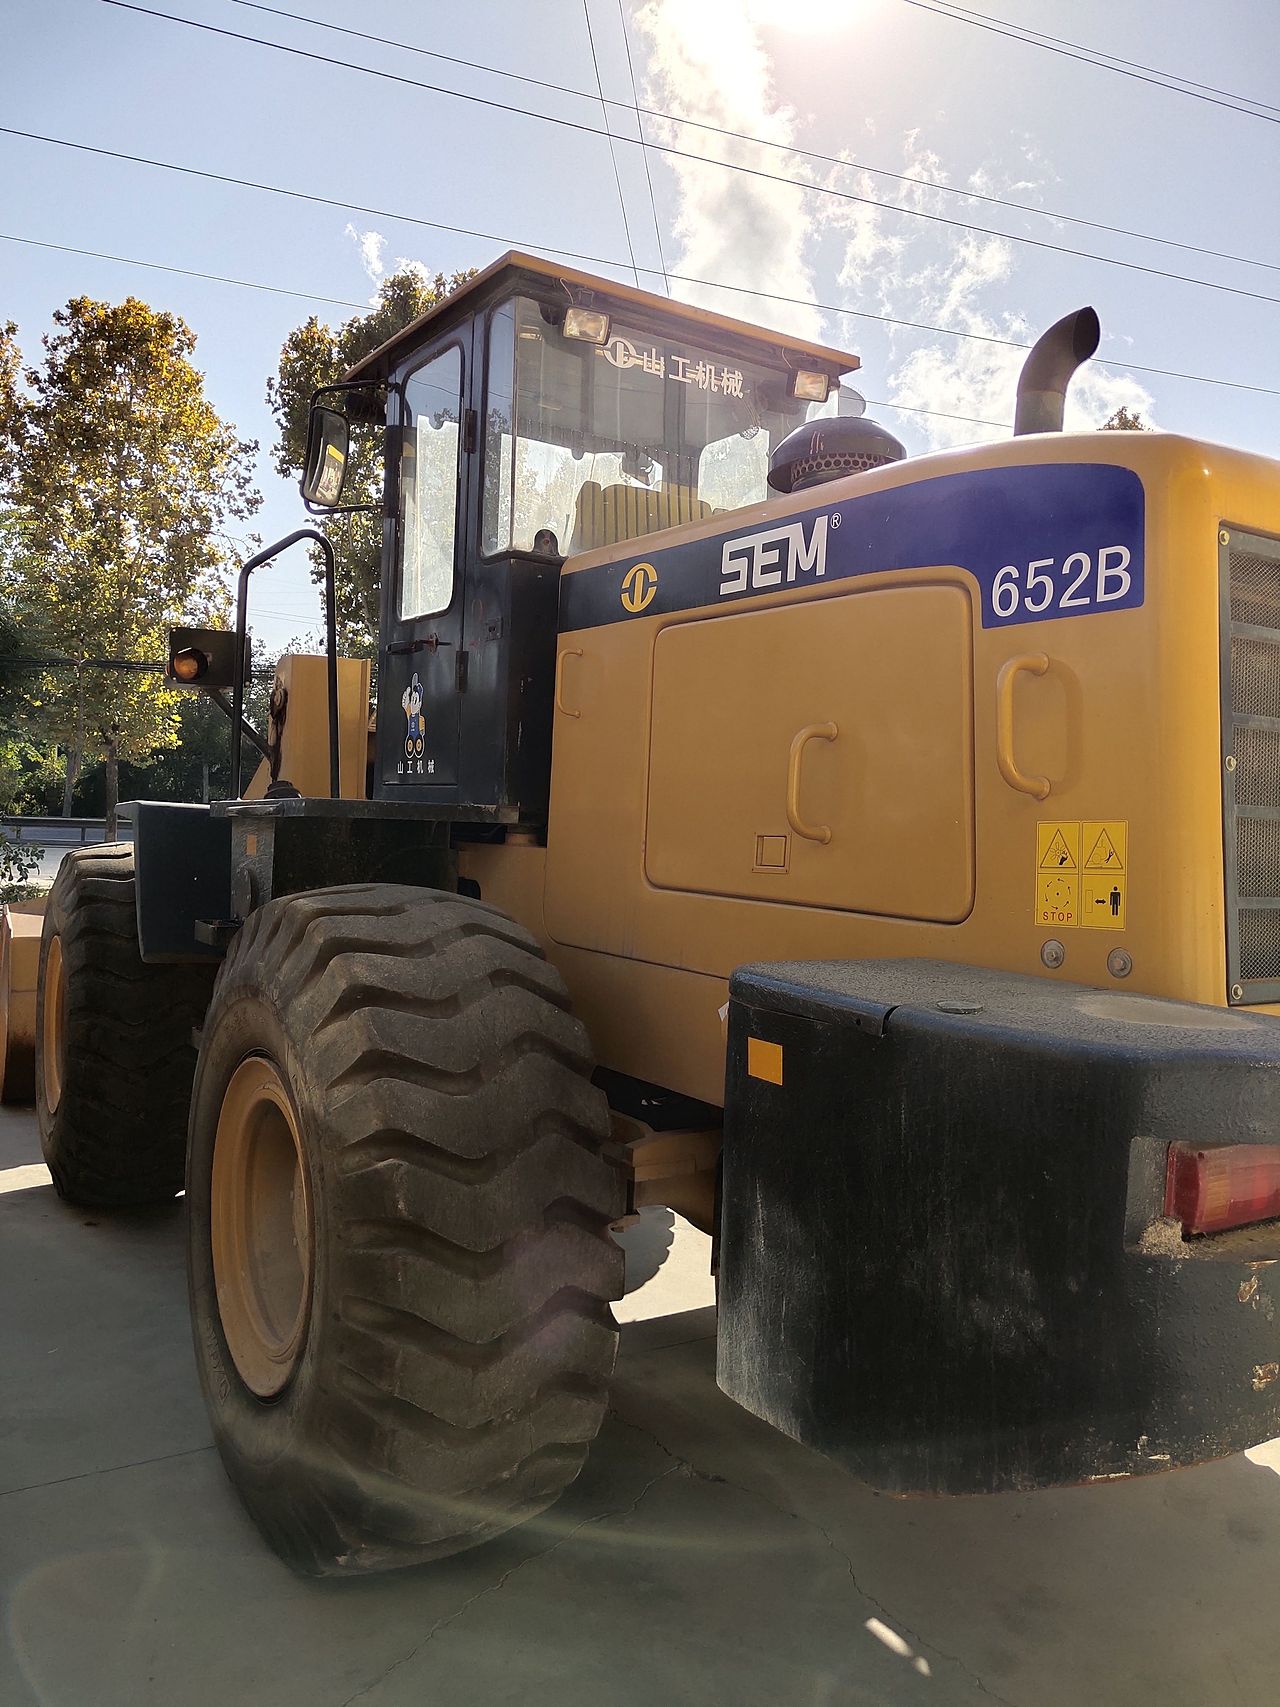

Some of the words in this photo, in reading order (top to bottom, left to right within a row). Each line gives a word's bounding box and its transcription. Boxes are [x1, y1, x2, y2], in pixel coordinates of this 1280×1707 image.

[643, 347, 744, 398] 山工机械
[992, 545, 1131, 617] 652B
[397, 760, 435, 774] 山工机械
[1042, 911, 1073, 922] STOP
